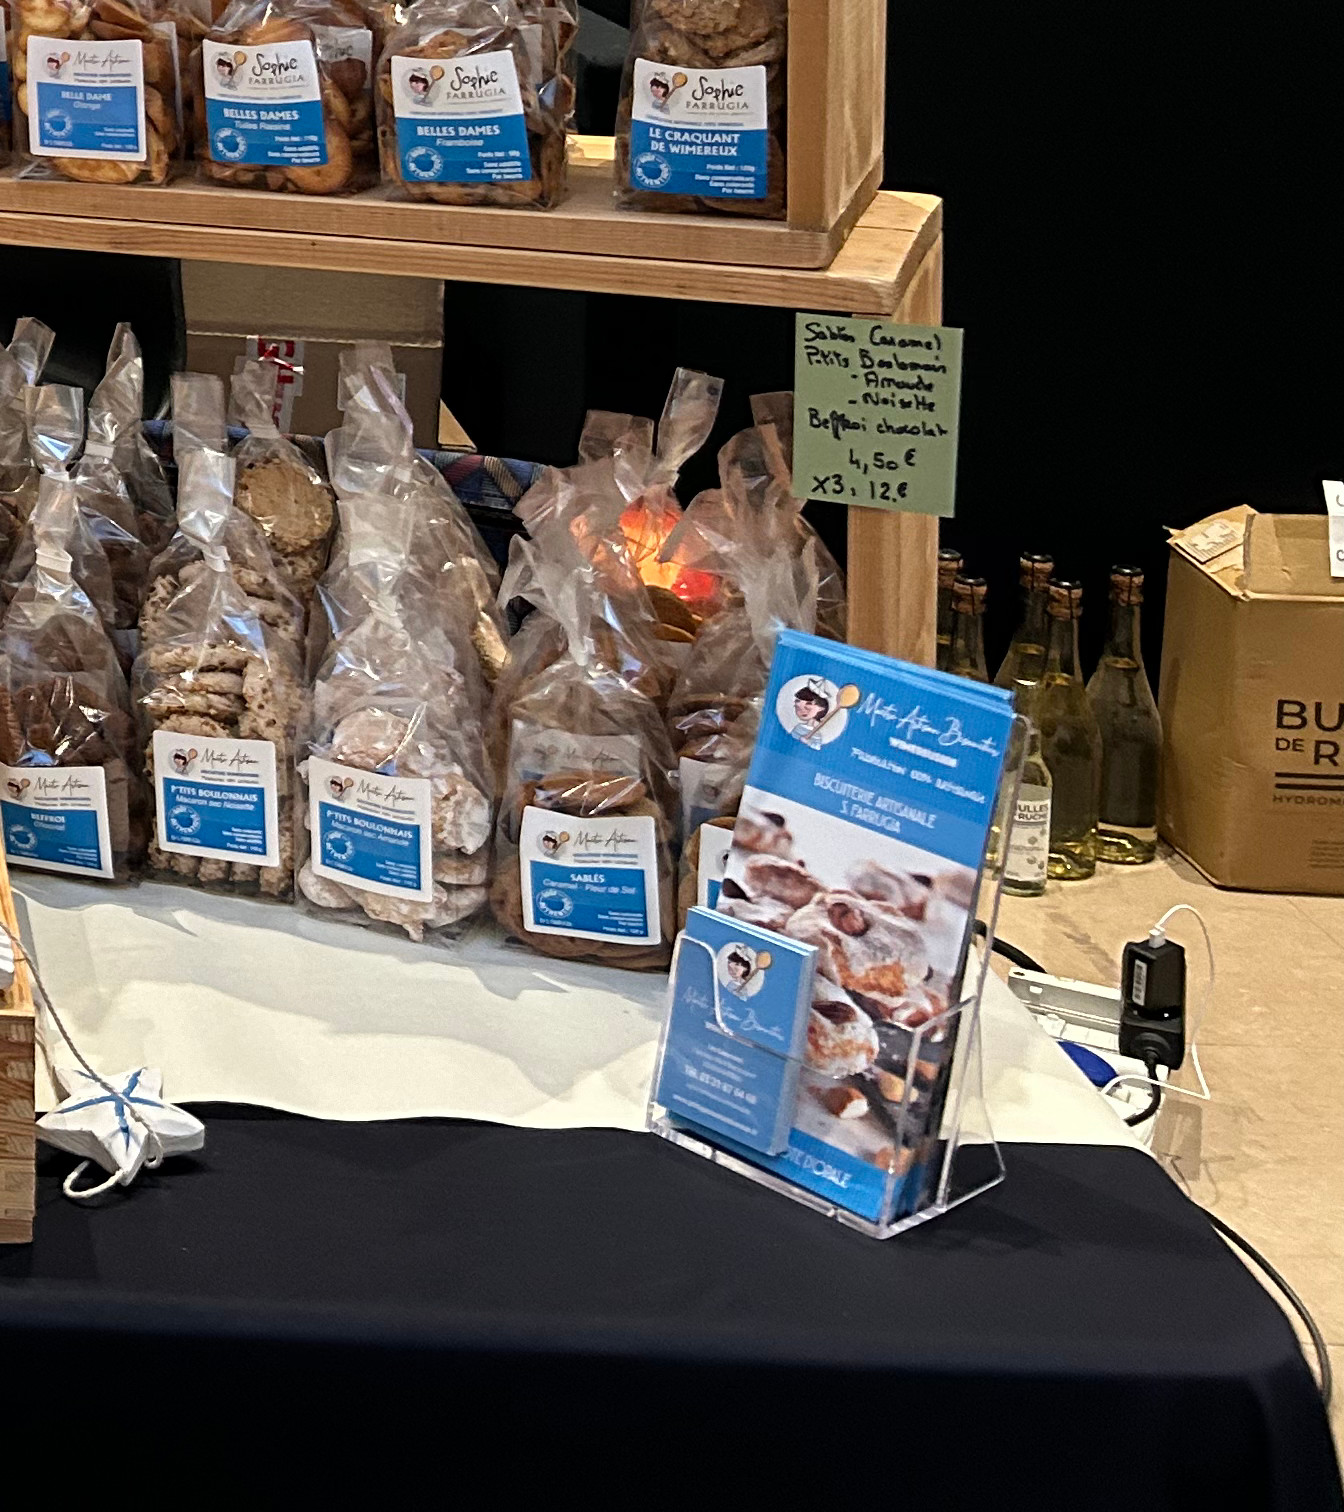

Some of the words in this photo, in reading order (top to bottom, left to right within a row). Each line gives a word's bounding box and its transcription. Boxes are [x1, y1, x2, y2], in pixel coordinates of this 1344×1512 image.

[691, 75, 745, 102] Sophie
[259, 108, 300, 122] DAMES
[457, 124, 501, 137] DAMES
[648, 126, 663, 140] LE
[664, 129, 742, 145] CRAQUANT
[650, 139, 667, 153] DE
[668, 142, 739, 158] WIMEREUX
[1274, 737, 1306, 753] DE
